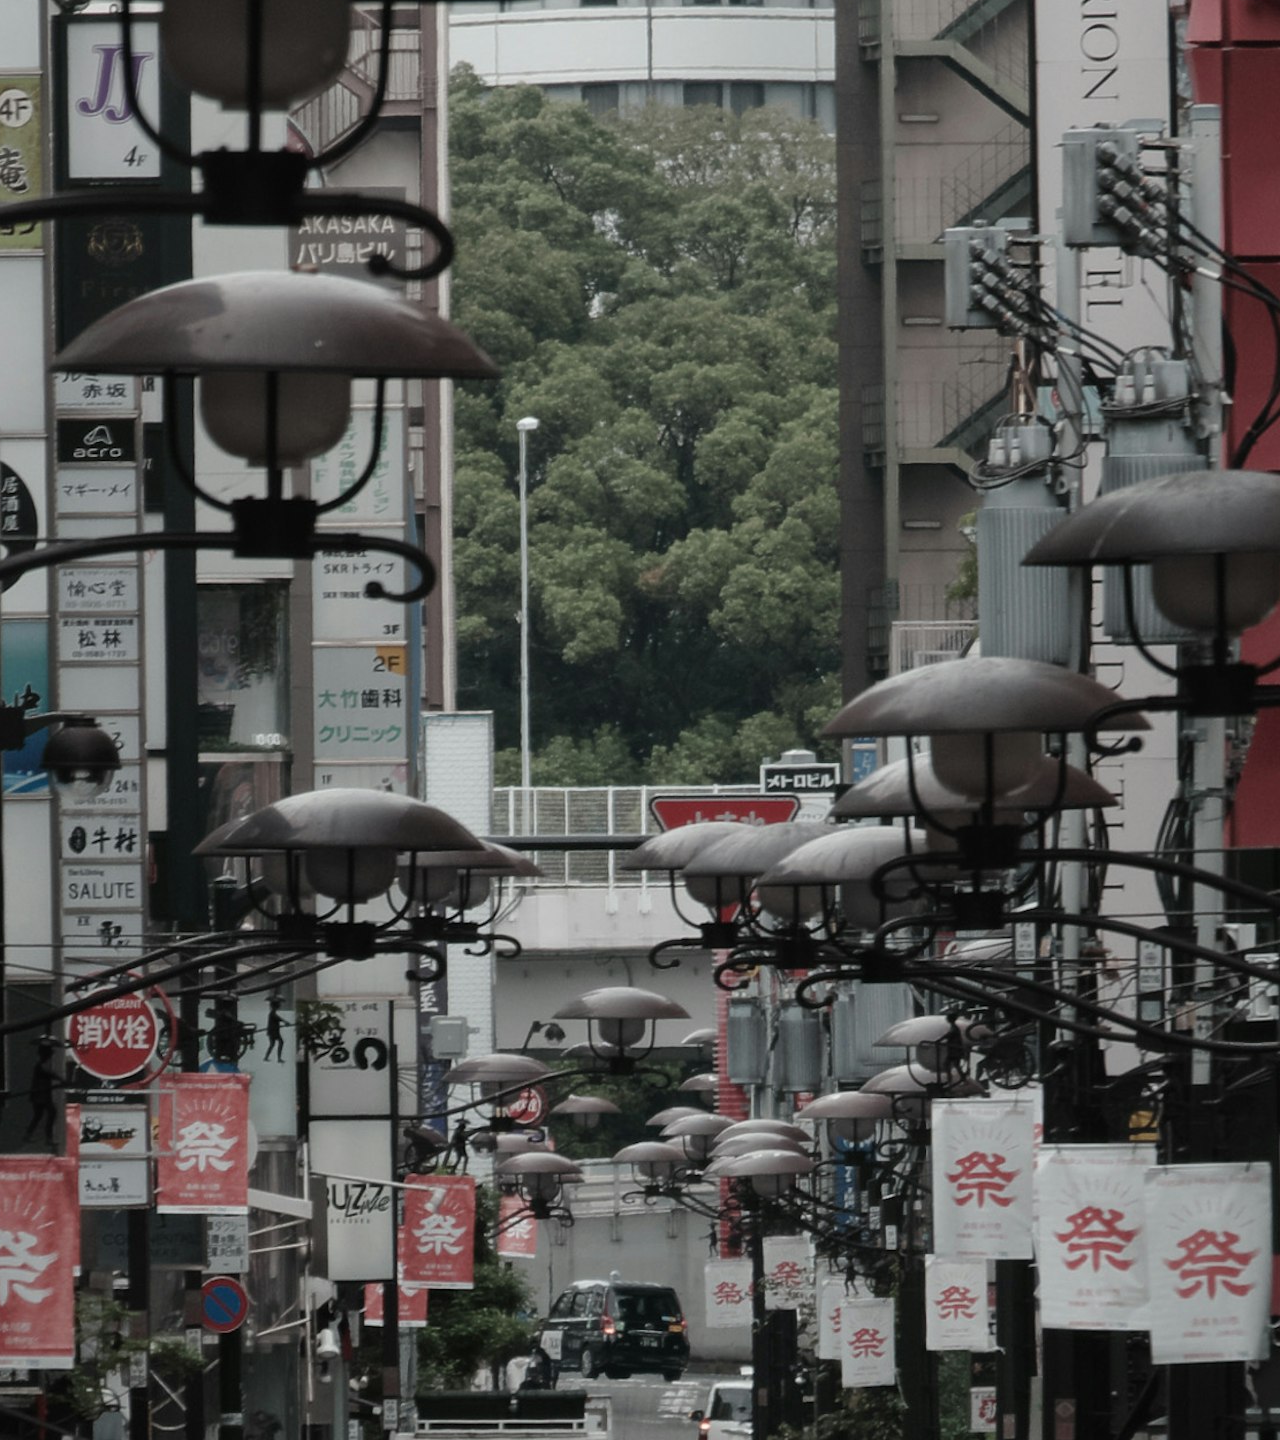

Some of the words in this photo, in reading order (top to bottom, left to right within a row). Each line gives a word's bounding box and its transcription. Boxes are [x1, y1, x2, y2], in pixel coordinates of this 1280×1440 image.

[123, 145, 148, 167] 4F
[297, 214, 396, 235] AKASAKA
[82, 384, 127, 399] 赤坂
[72, 445, 123, 458] acro
[1, 476, 20, 532] 居酒屋
[78, 630, 122, 648] 松林
[383, 624, 400, 635] 3F
[372, 655, 400, 672] 2F
[318, 689, 402, 709] 大竹歯科
[318, 725, 402, 743] クリニック
[767, 773, 835, 789] メトロビル
[68, 883, 135, 900] SALUTE
[77, 1015, 150, 1049] 消火栓
[169, 1121, 239, 1174] 祭
[943, 1151, 1022, 1209] 祭
[326, 1183, 384, 1211] UZZ
[411, 1212, 467, 1257] 祭
[1053, 1206, 1144, 1272] 祭
[1162, 1228, 1260, 1300] 祭
[933, 1285, 979, 1323] 祭
[846, 1326, 888, 1360] 祭
